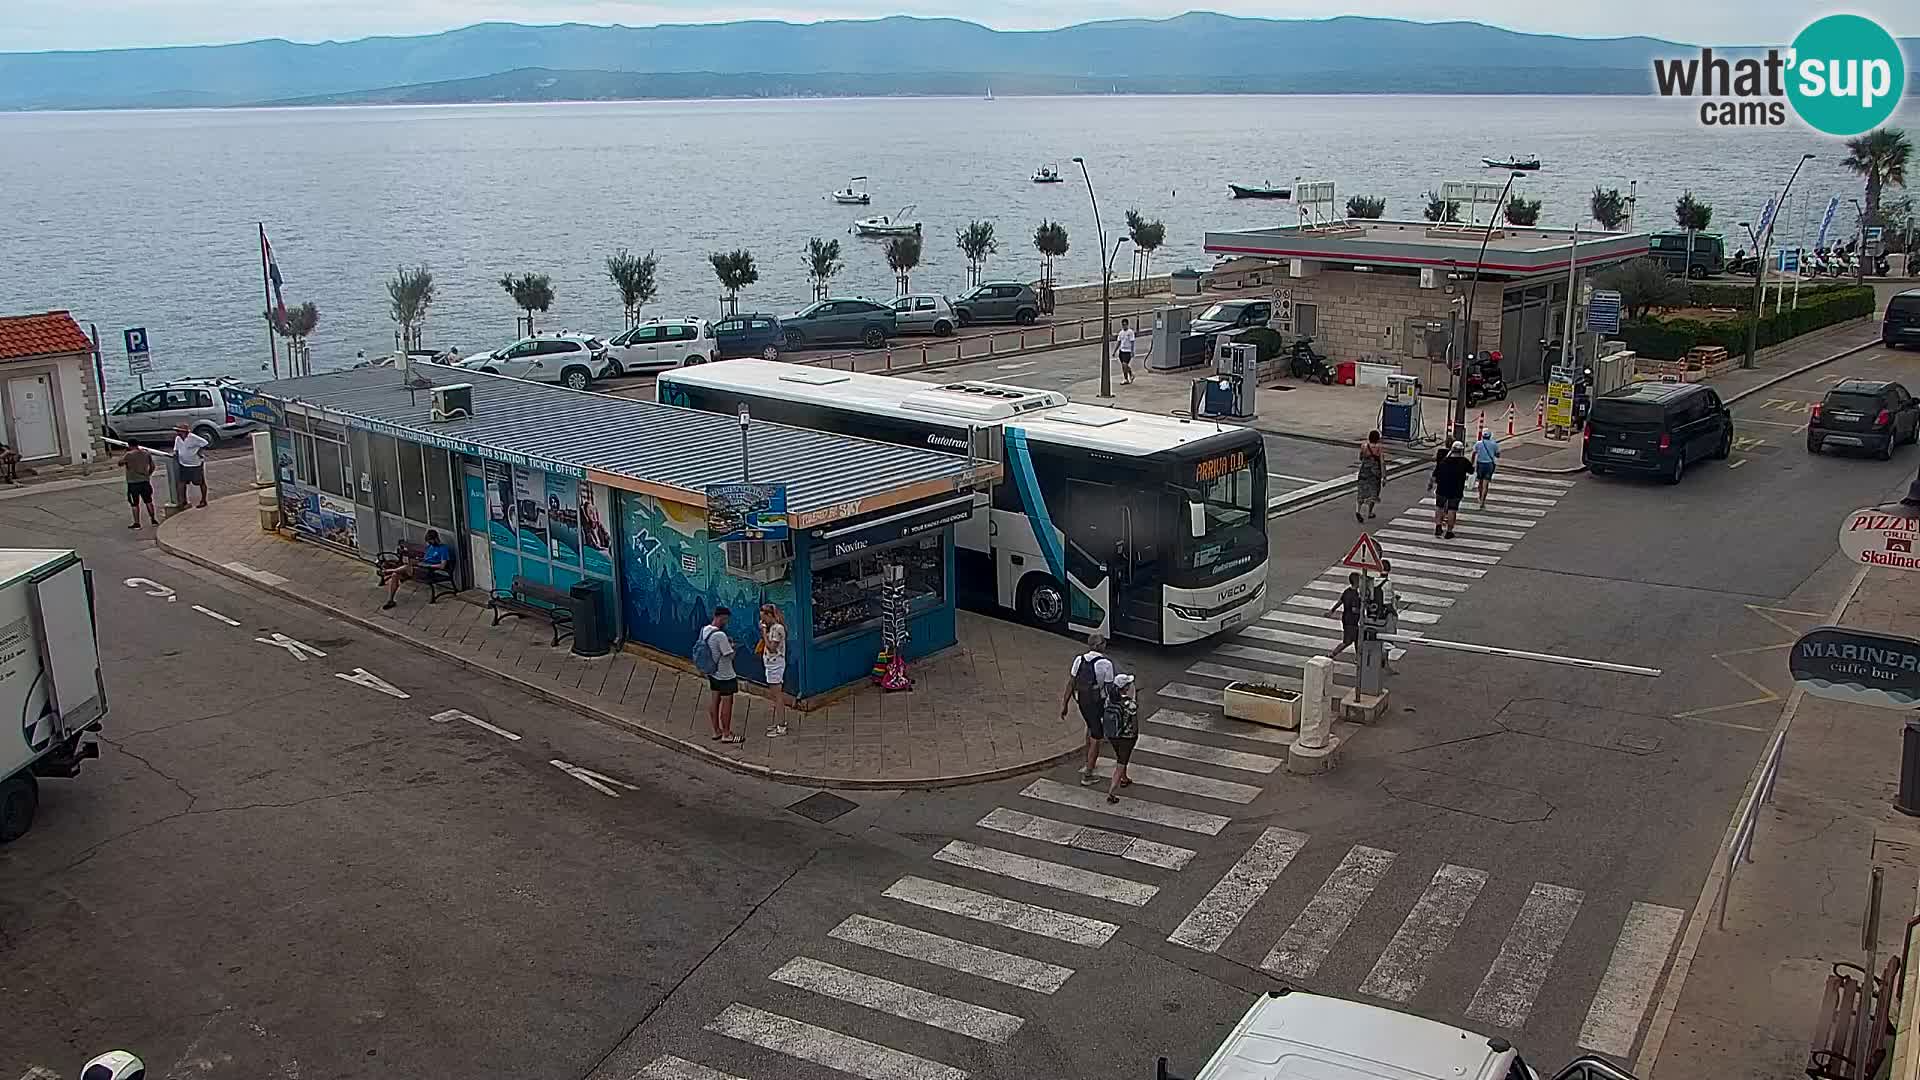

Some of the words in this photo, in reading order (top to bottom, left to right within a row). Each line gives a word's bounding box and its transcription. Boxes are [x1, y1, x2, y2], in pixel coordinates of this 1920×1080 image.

[130, 331, 142, 350] P
[437, 438, 468, 452] POSTAJA
[927, 433, 968, 450] Autotran
[478, 446, 493, 458] BUS
[494, 450, 526, 465] STATION
[529, 458, 554, 471] TICKET
[555, 464, 582, 477] OFFICE
[1849, 515, 1920, 532] PIZZE
[1217, 584, 1247, 602] IVECO
[1803, 642, 1920, 673] MARINER
[1830, 662, 1867, 675] caffe
[1872, 666, 1899, 680] bar
